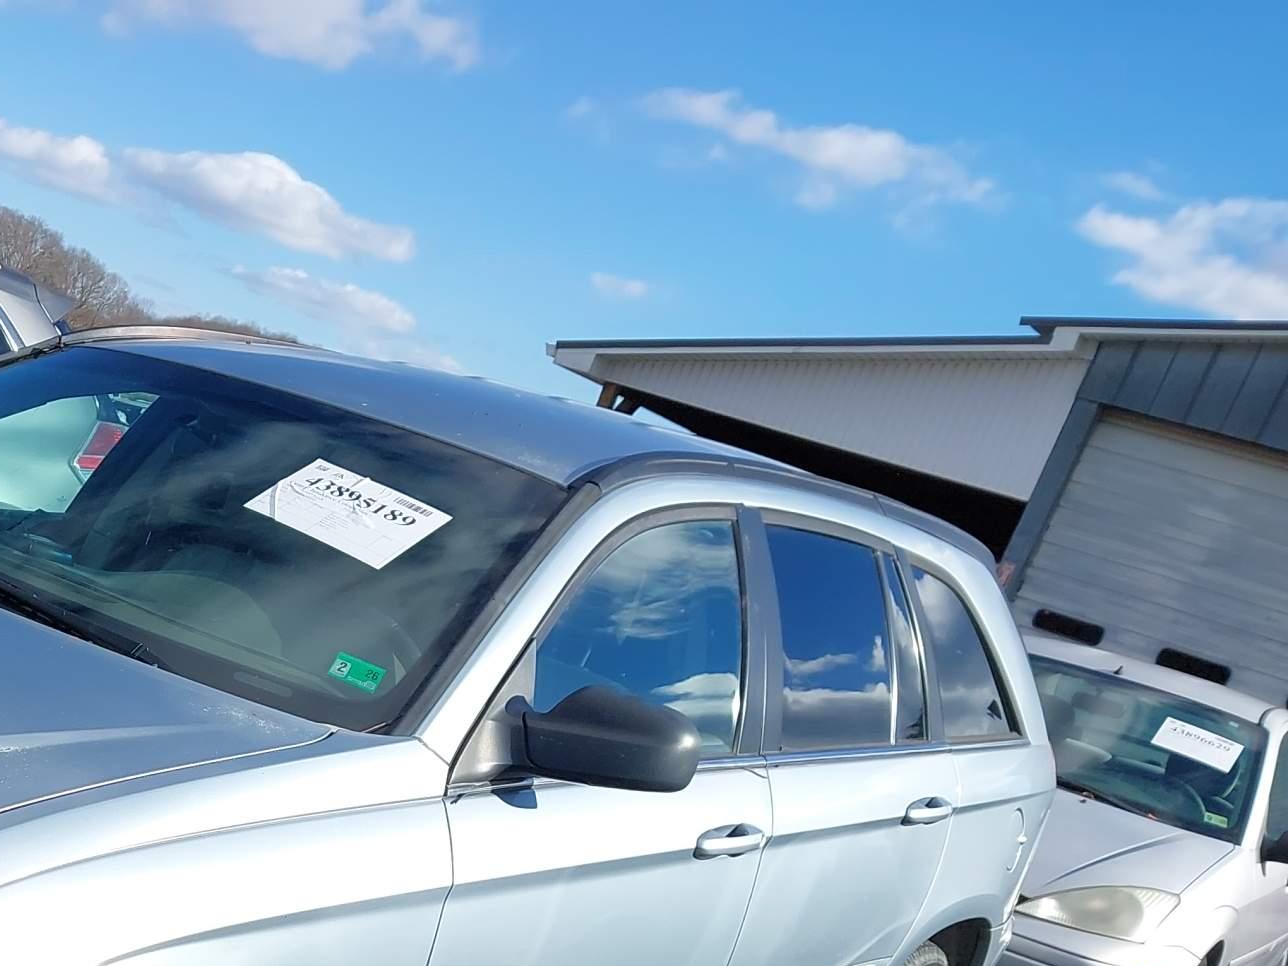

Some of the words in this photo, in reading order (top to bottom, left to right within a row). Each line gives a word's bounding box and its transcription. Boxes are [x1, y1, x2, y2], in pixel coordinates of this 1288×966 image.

[304, 477, 417, 526] 43895189
[337, 661, 348, 673] 2
[365, 669, 380, 681] 26
